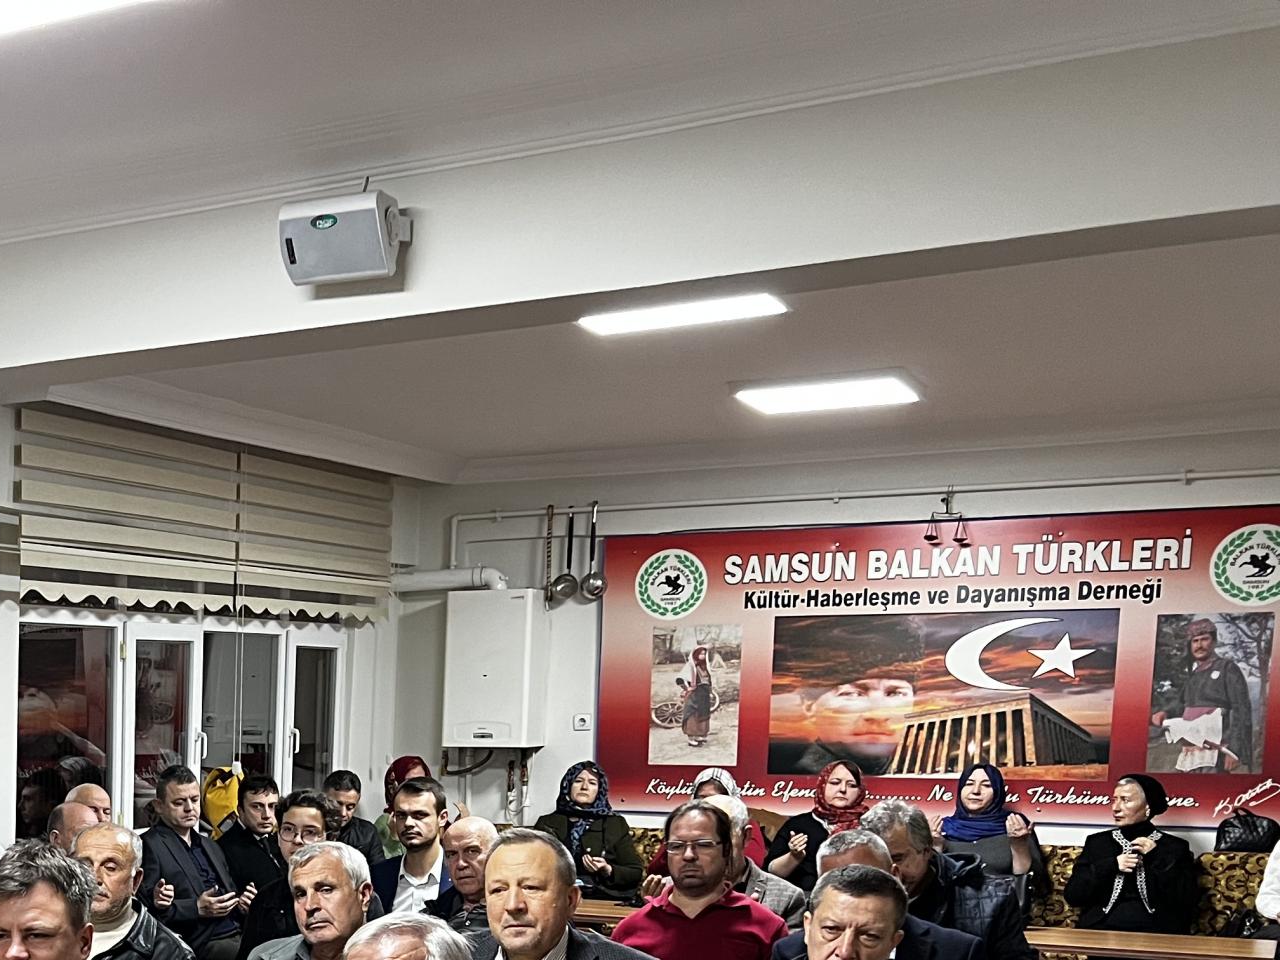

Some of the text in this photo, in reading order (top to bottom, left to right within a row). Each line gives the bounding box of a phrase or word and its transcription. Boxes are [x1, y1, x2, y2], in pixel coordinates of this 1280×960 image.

[724, 528, 1193, 585] SAMSUN BALKAN TÜRKLERİ
[744, 578, 1162, 611] Kültür-Haberleşme ve Dayanışma Derneği
[645, 778, 694, 799] Köylü
[926, 784, 953, 801] Ne
[1026, 786, 1111, 805] Türküm
